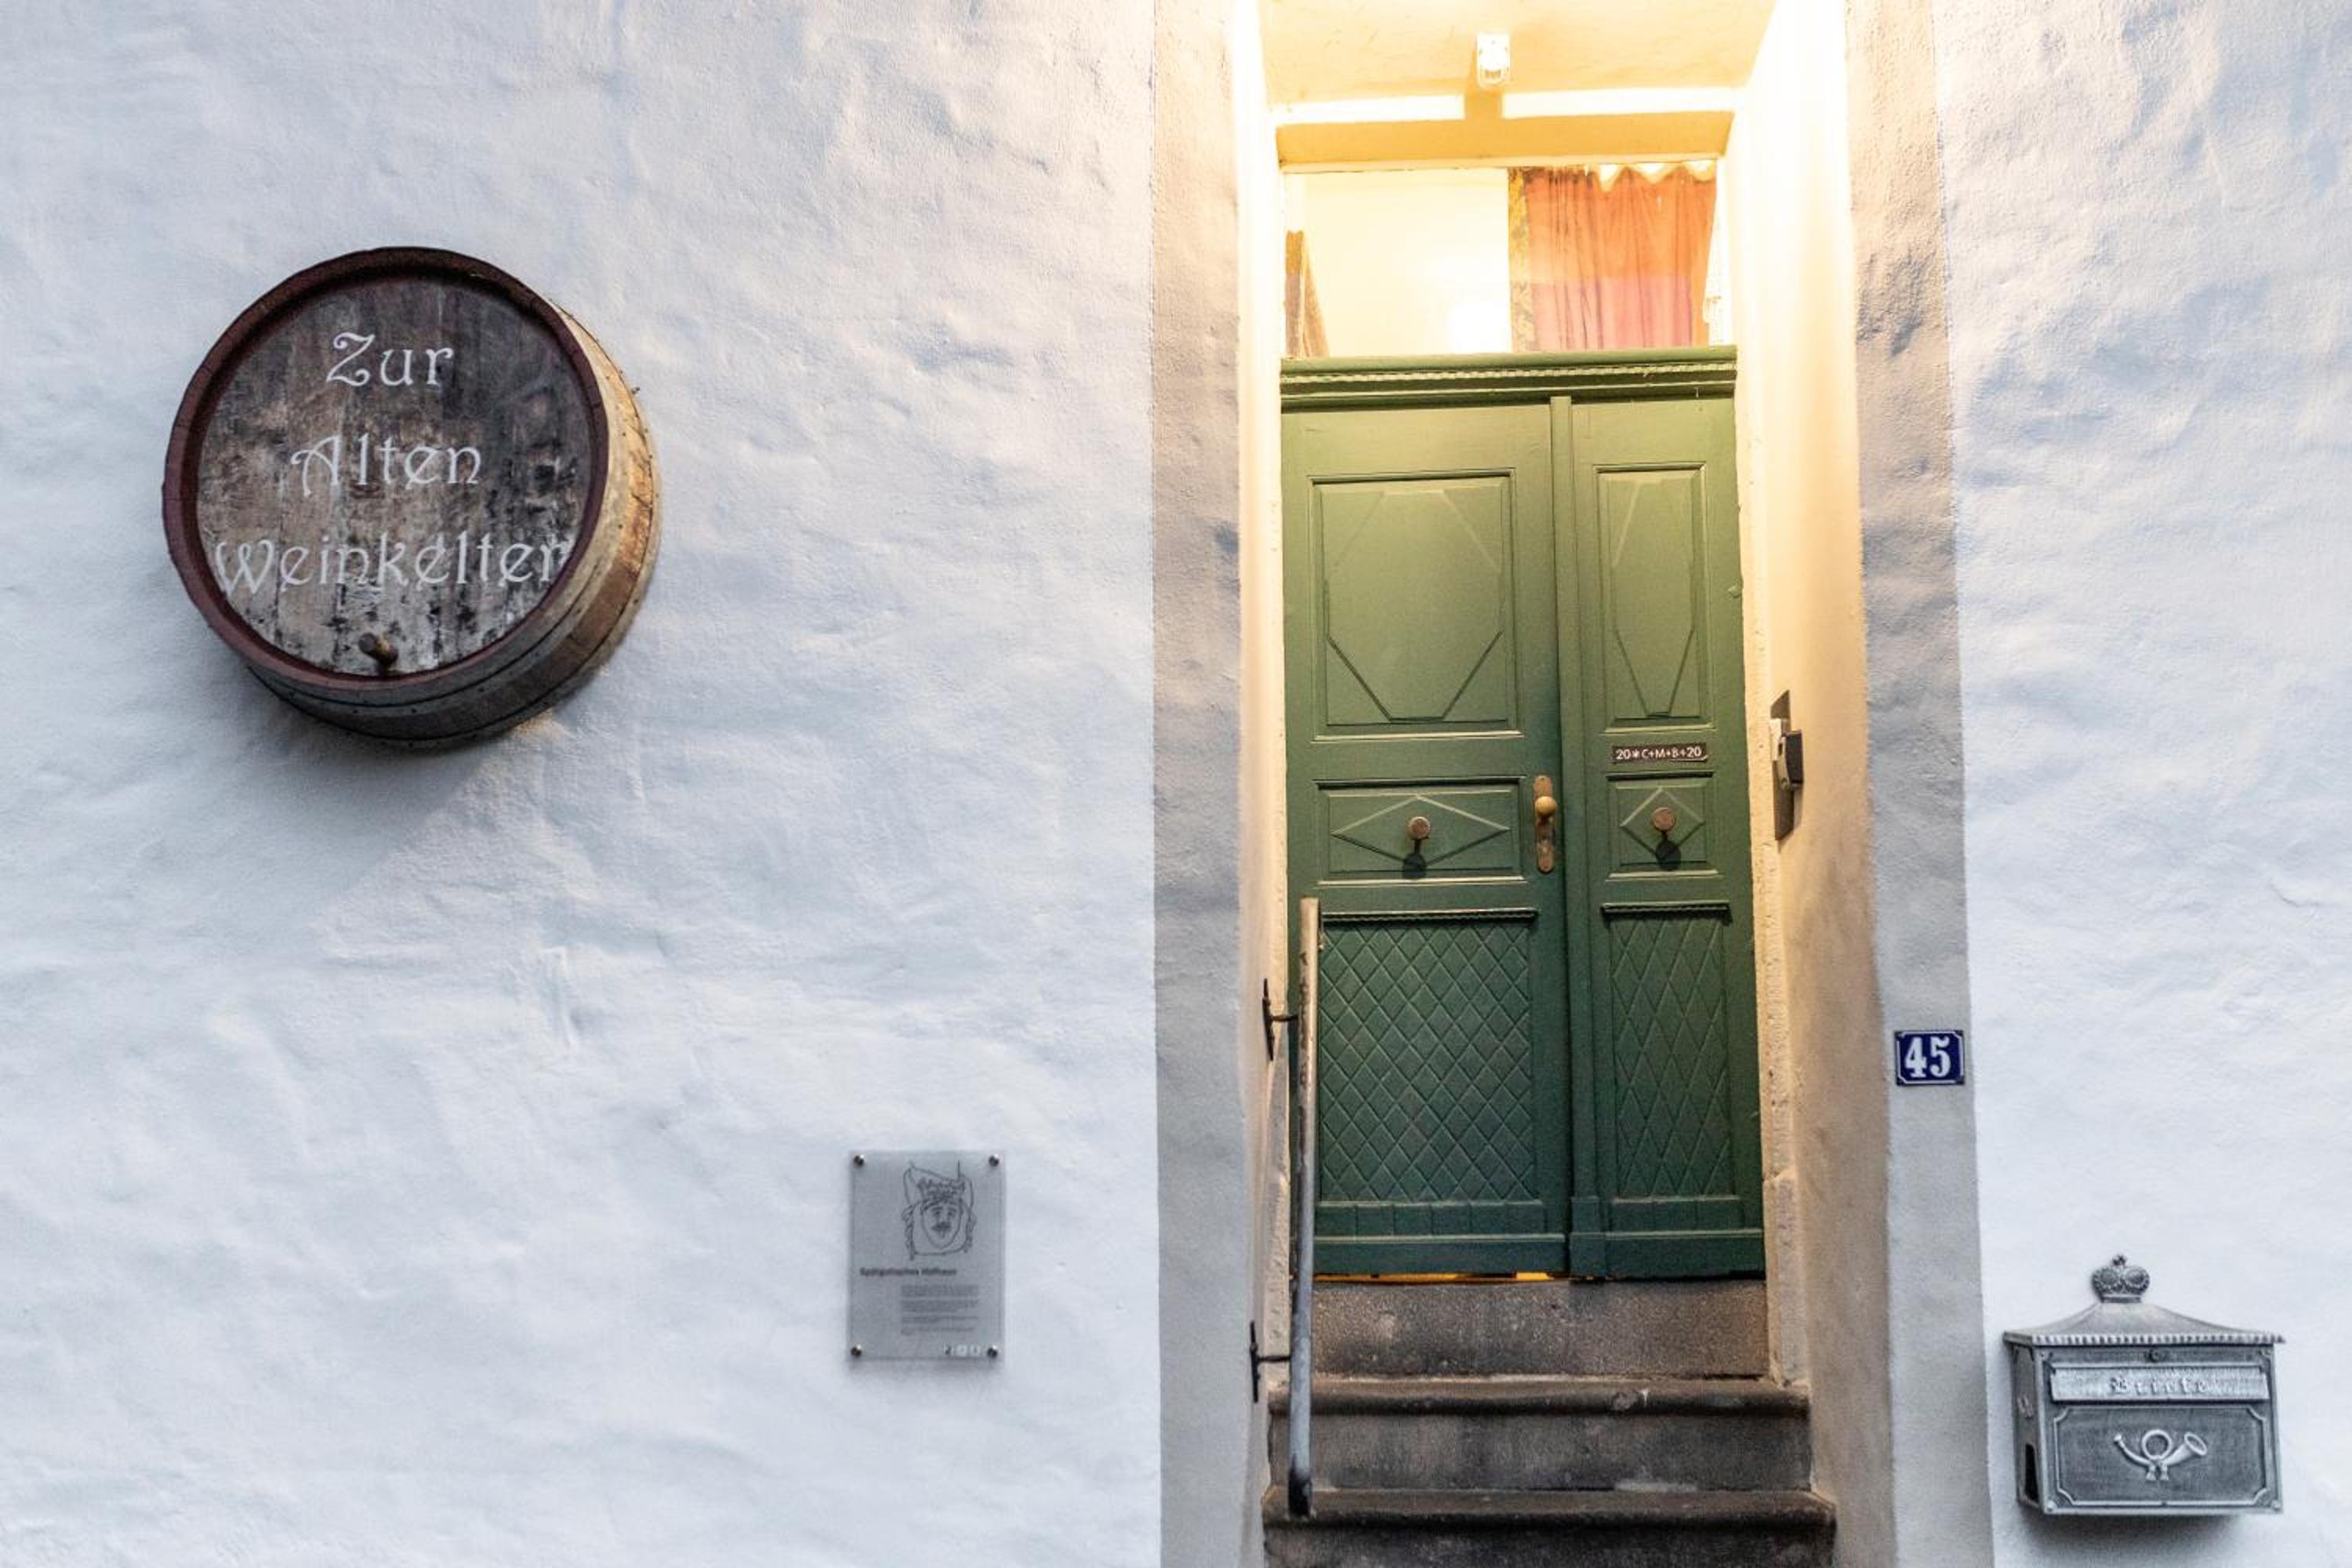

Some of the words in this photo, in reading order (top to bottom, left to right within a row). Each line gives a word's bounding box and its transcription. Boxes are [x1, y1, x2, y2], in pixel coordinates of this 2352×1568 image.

[326, 331, 456, 389] Zur
[290, 432, 483, 499] Alten
[214, 532, 571, 596] Weinkelter
[1904, 1036, 1951, 1079] 45
